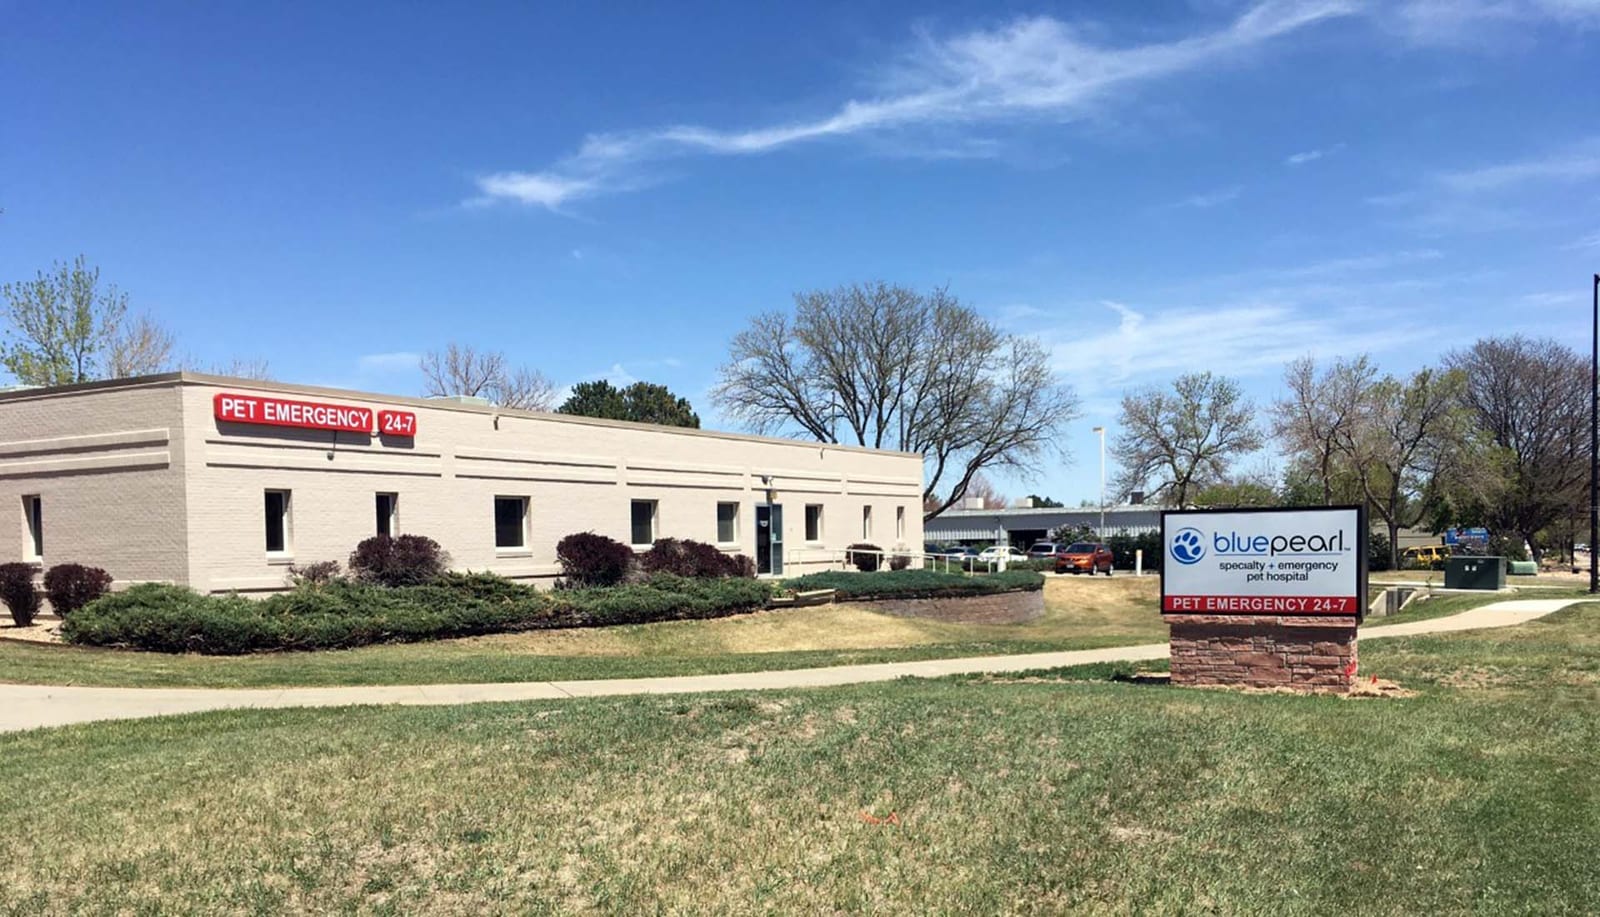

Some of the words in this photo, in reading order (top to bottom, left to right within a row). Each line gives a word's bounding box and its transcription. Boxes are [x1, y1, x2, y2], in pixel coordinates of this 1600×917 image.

[221, 398, 257, 418] PET
[263, 402, 370, 428] EMERGENCY
[384, 413, 414, 432] 24-7
[1213, 529, 1343, 557] bluepearl
[1219, 560, 1265, 571] specialty
[1278, 561, 1338, 572] emergency
[1246, 571, 1264, 582] pet
[1266, 571, 1309, 582] hospital
[1173, 598, 1201, 609] PET
[1206, 598, 1308, 610] EMERGENCY
[1313, 599, 1348, 611] 24-7
